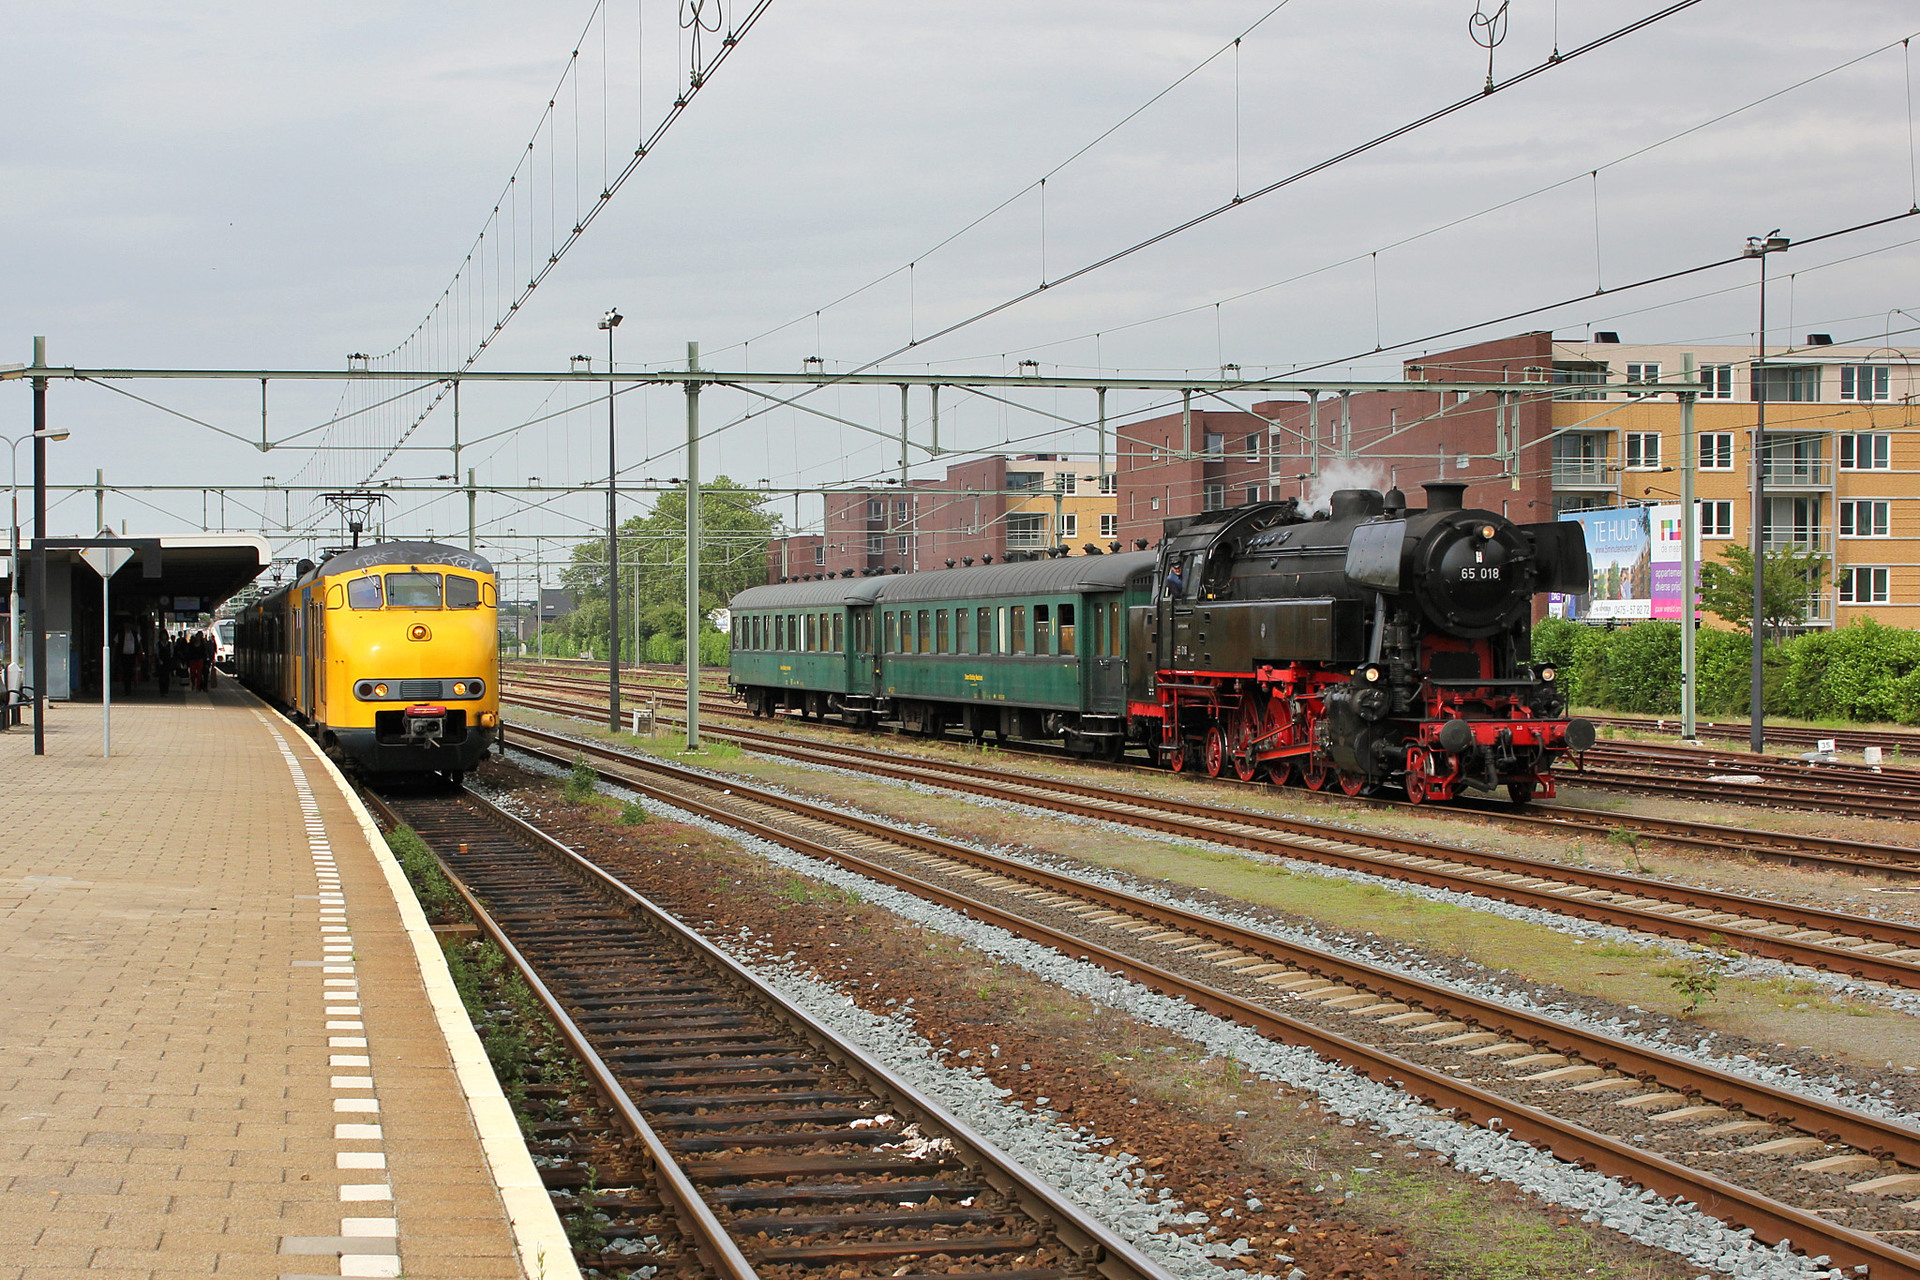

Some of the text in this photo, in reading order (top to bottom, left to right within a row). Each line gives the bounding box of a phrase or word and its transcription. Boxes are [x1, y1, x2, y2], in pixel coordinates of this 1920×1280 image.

[1593, 518, 1638, 542] TE HUUR
[1461, 567, 1499, 579] 65 018
[1613, 605, 1625, 615] 0475
[1630, 605, 1636, 615] 57
[1643, 605, 1650, 615] 72
